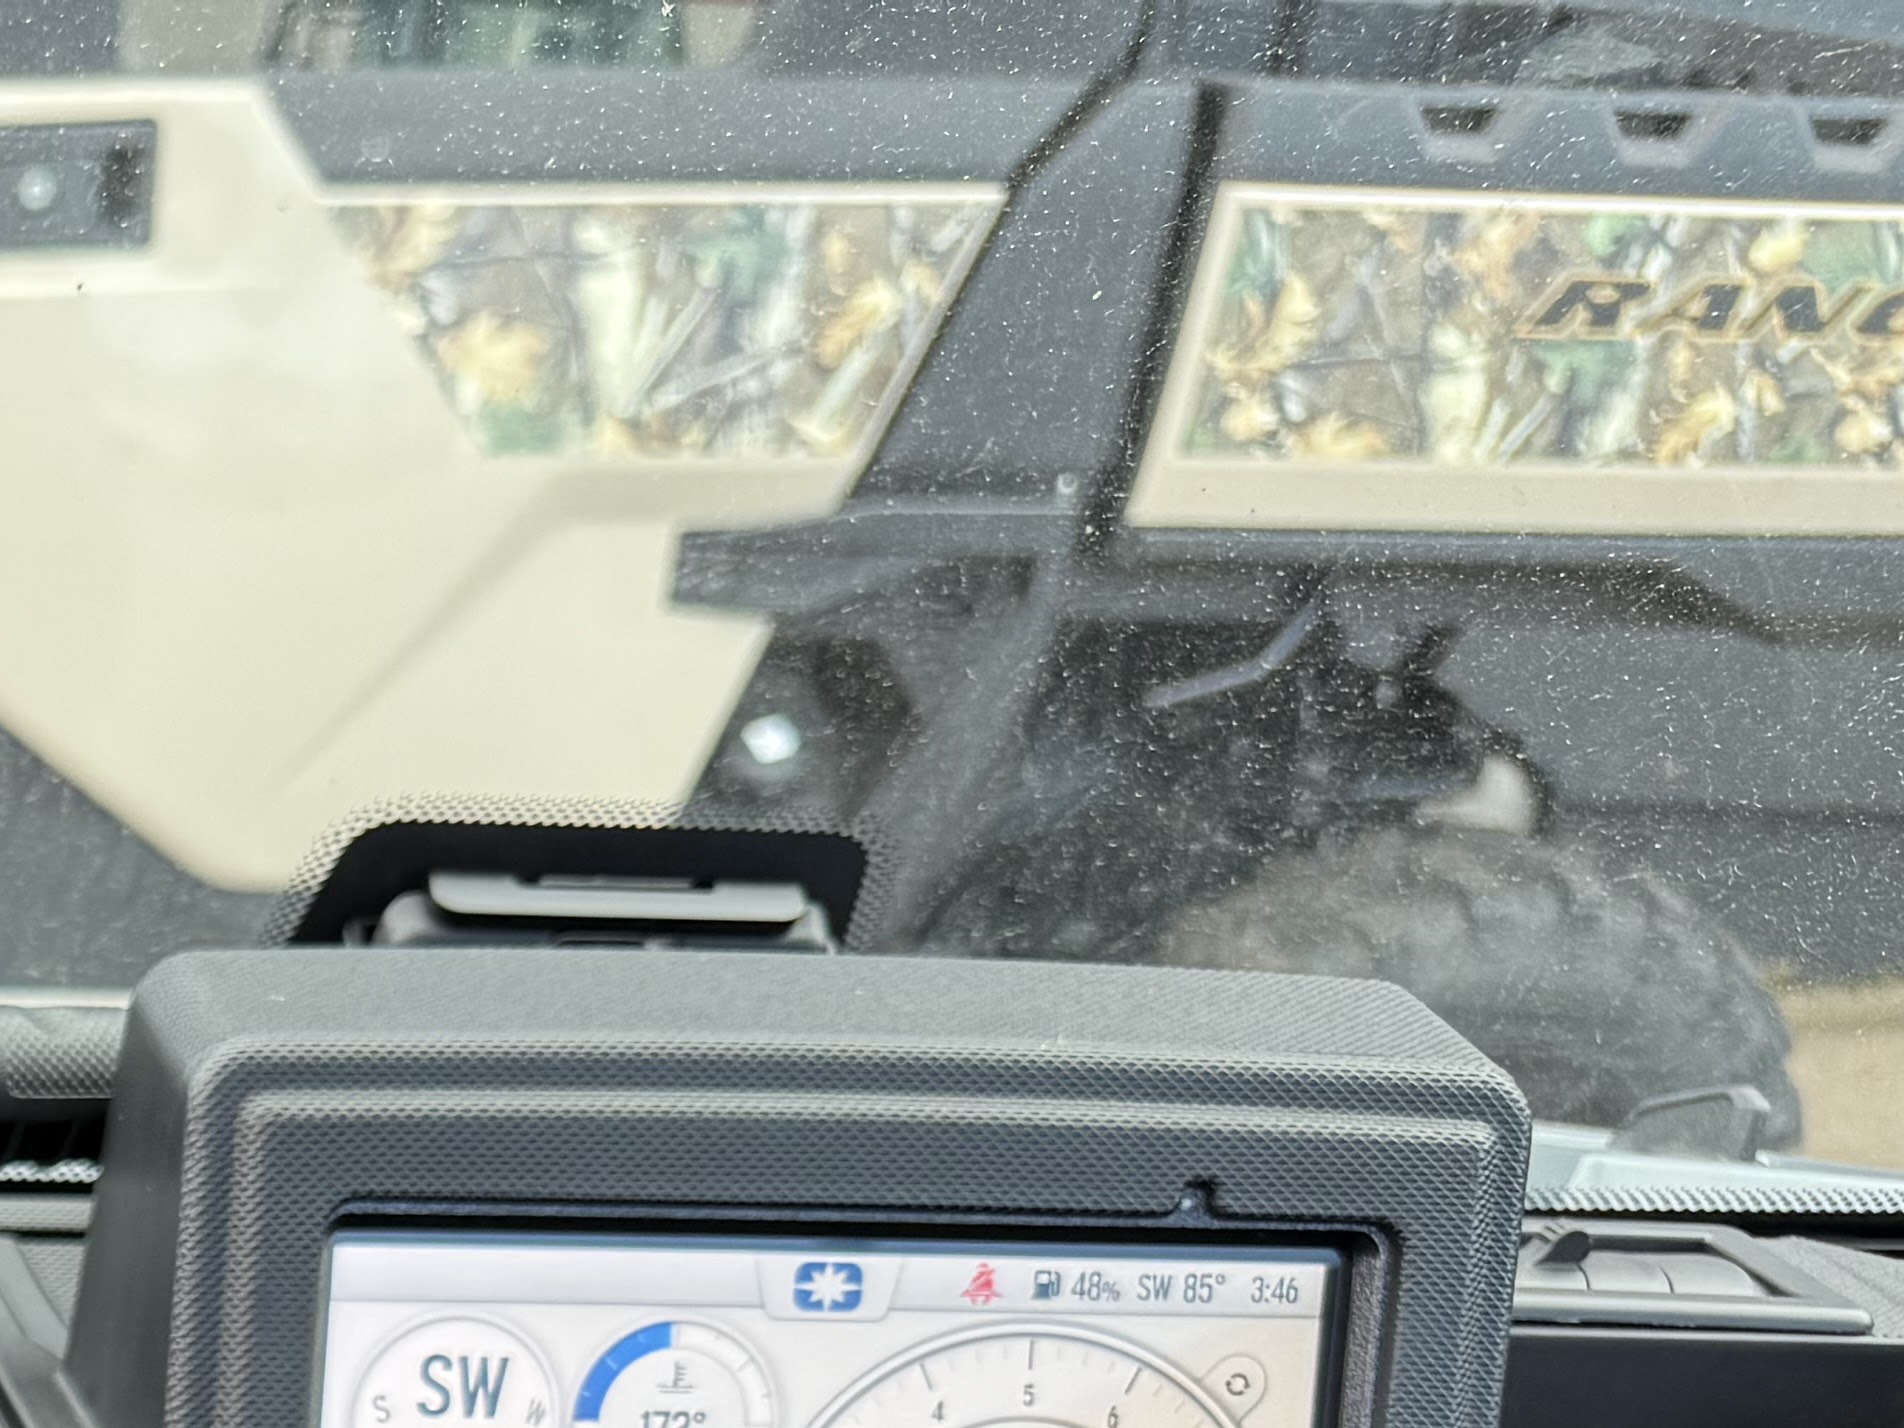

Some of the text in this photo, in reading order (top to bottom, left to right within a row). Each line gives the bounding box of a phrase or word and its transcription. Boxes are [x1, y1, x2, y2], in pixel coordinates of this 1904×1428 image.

[1137, 1273, 1174, 1302] SW
[1251, 1276, 1299, 1304] 3:46
[416, 1353, 510, 1420] SW
[1022, 1384, 1035, 1407] 5
[372, 1395, 391, 1423] S
[931, 1401, 944, 1422] 4
